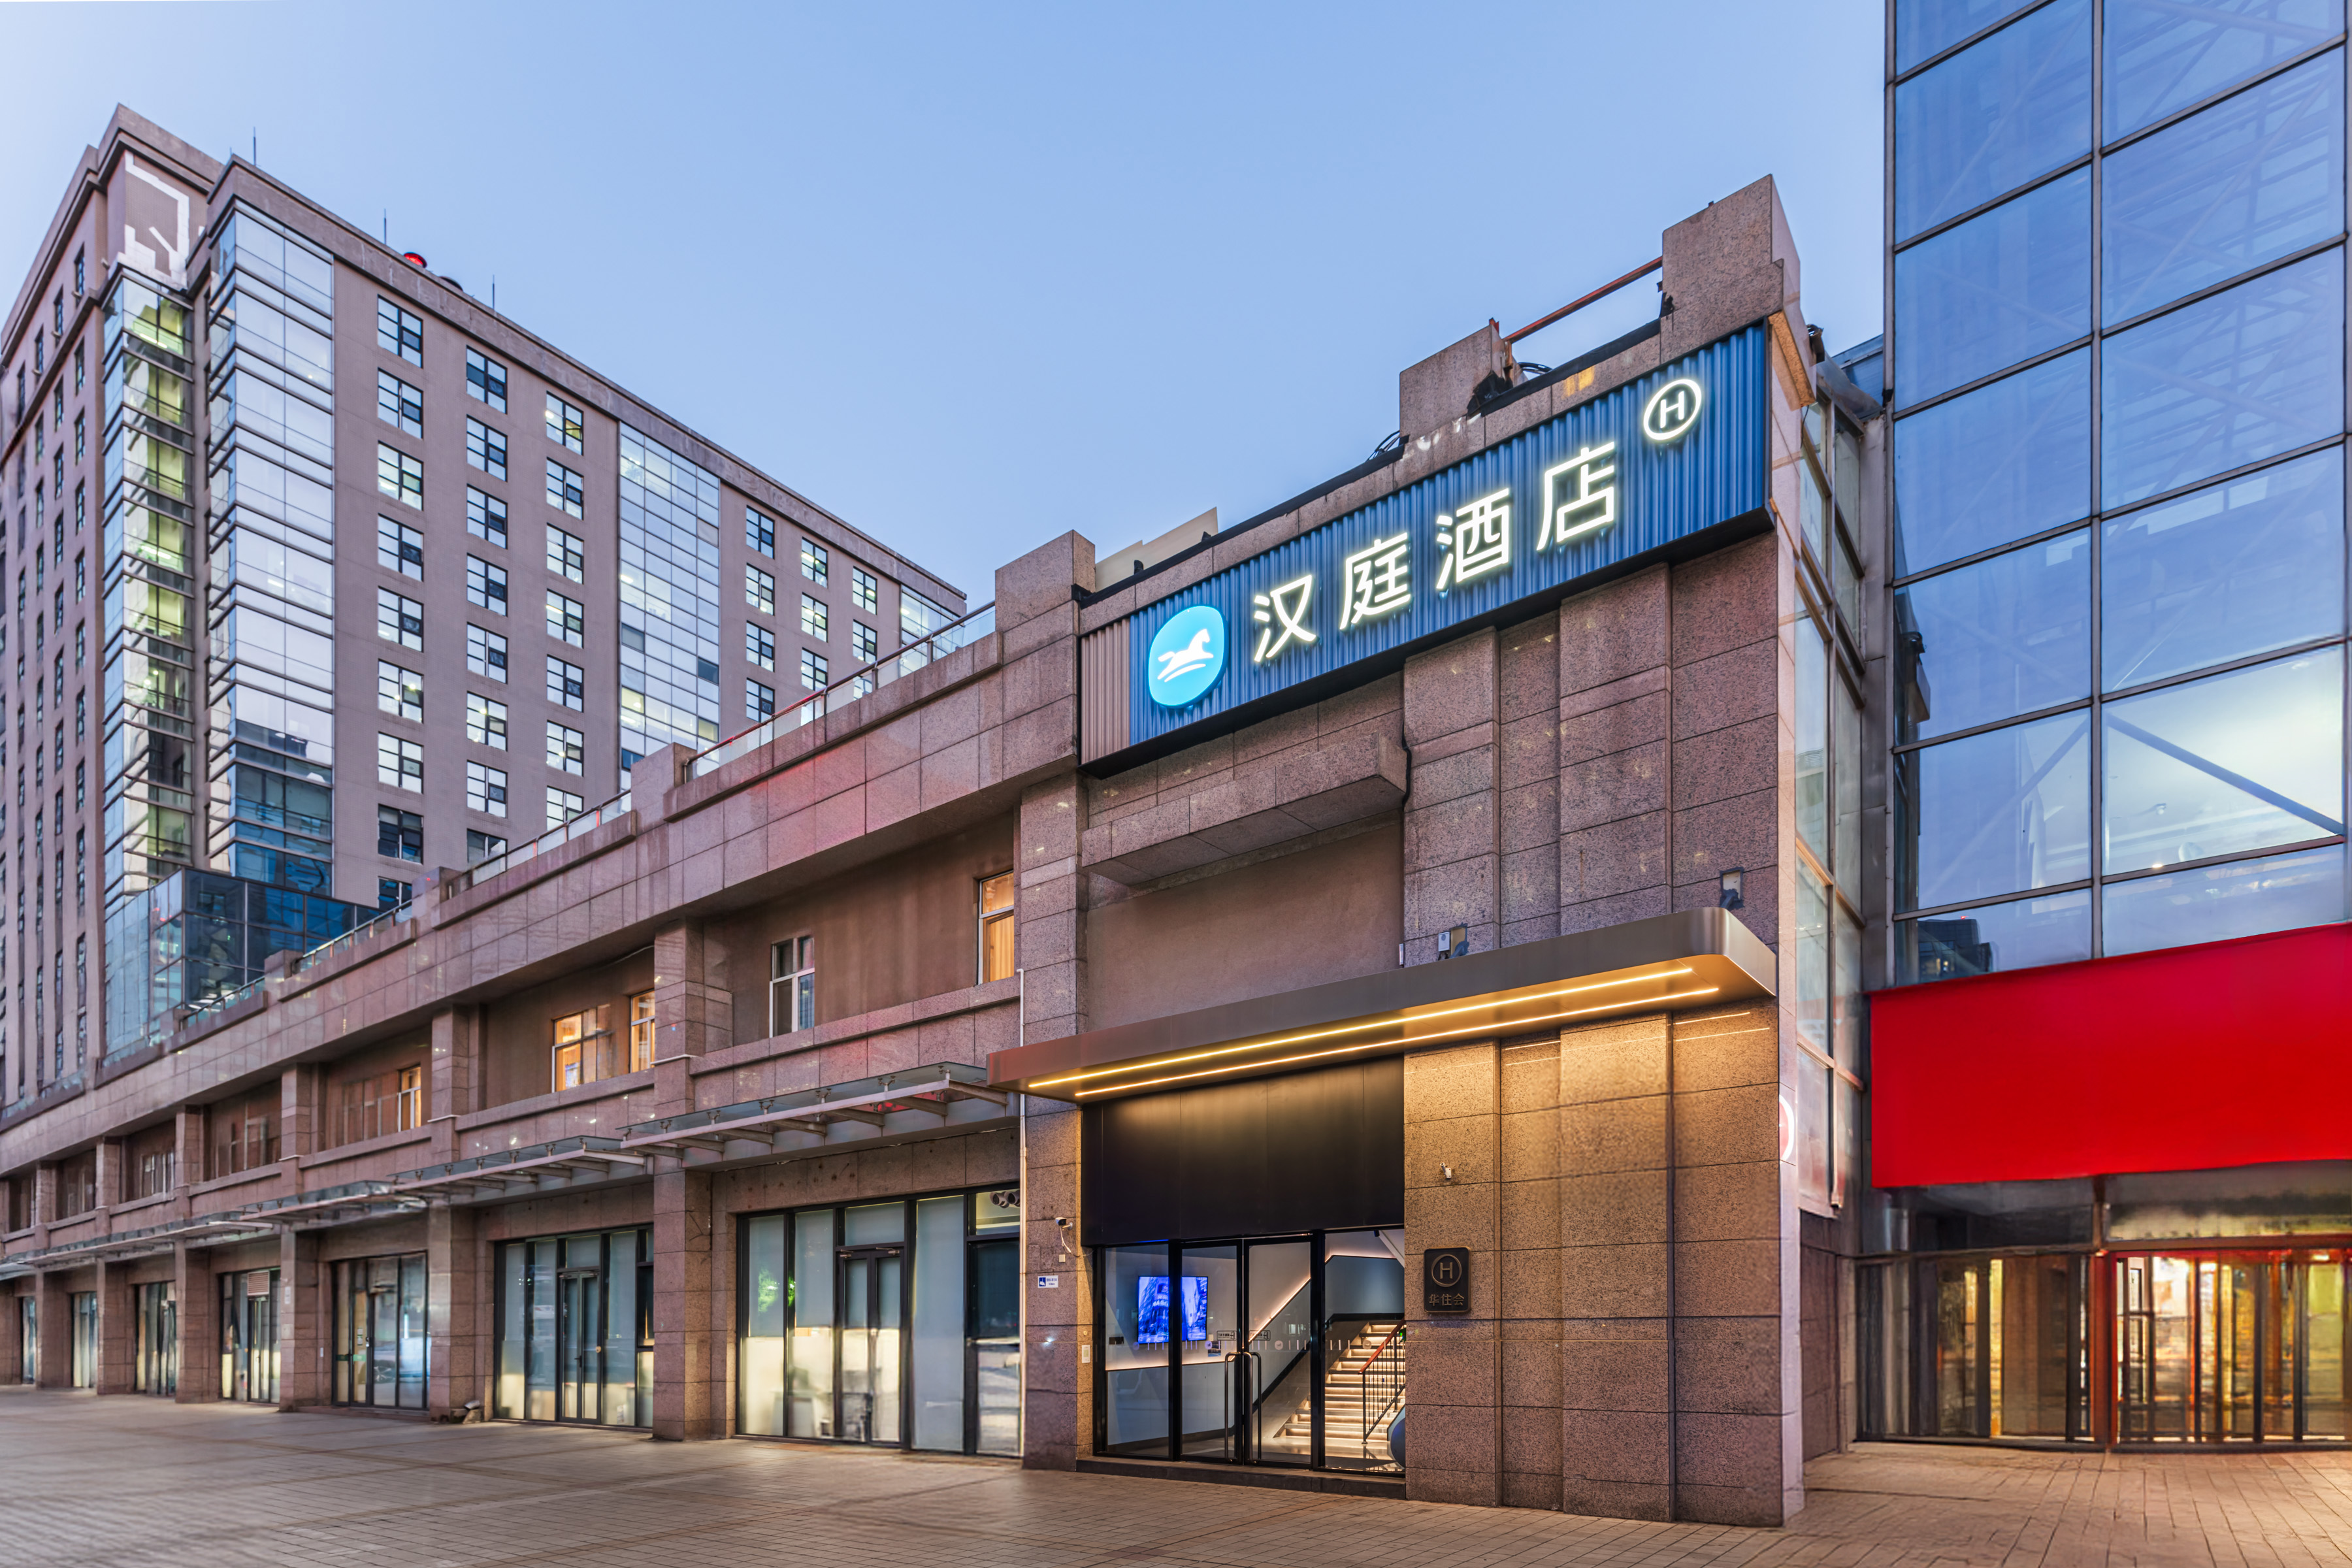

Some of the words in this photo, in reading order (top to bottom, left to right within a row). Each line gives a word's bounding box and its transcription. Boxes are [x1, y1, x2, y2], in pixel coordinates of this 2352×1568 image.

[1253, 441, 1615, 662] 汉庭酒店
[1429, 1293, 1465, 1306] 华住会
